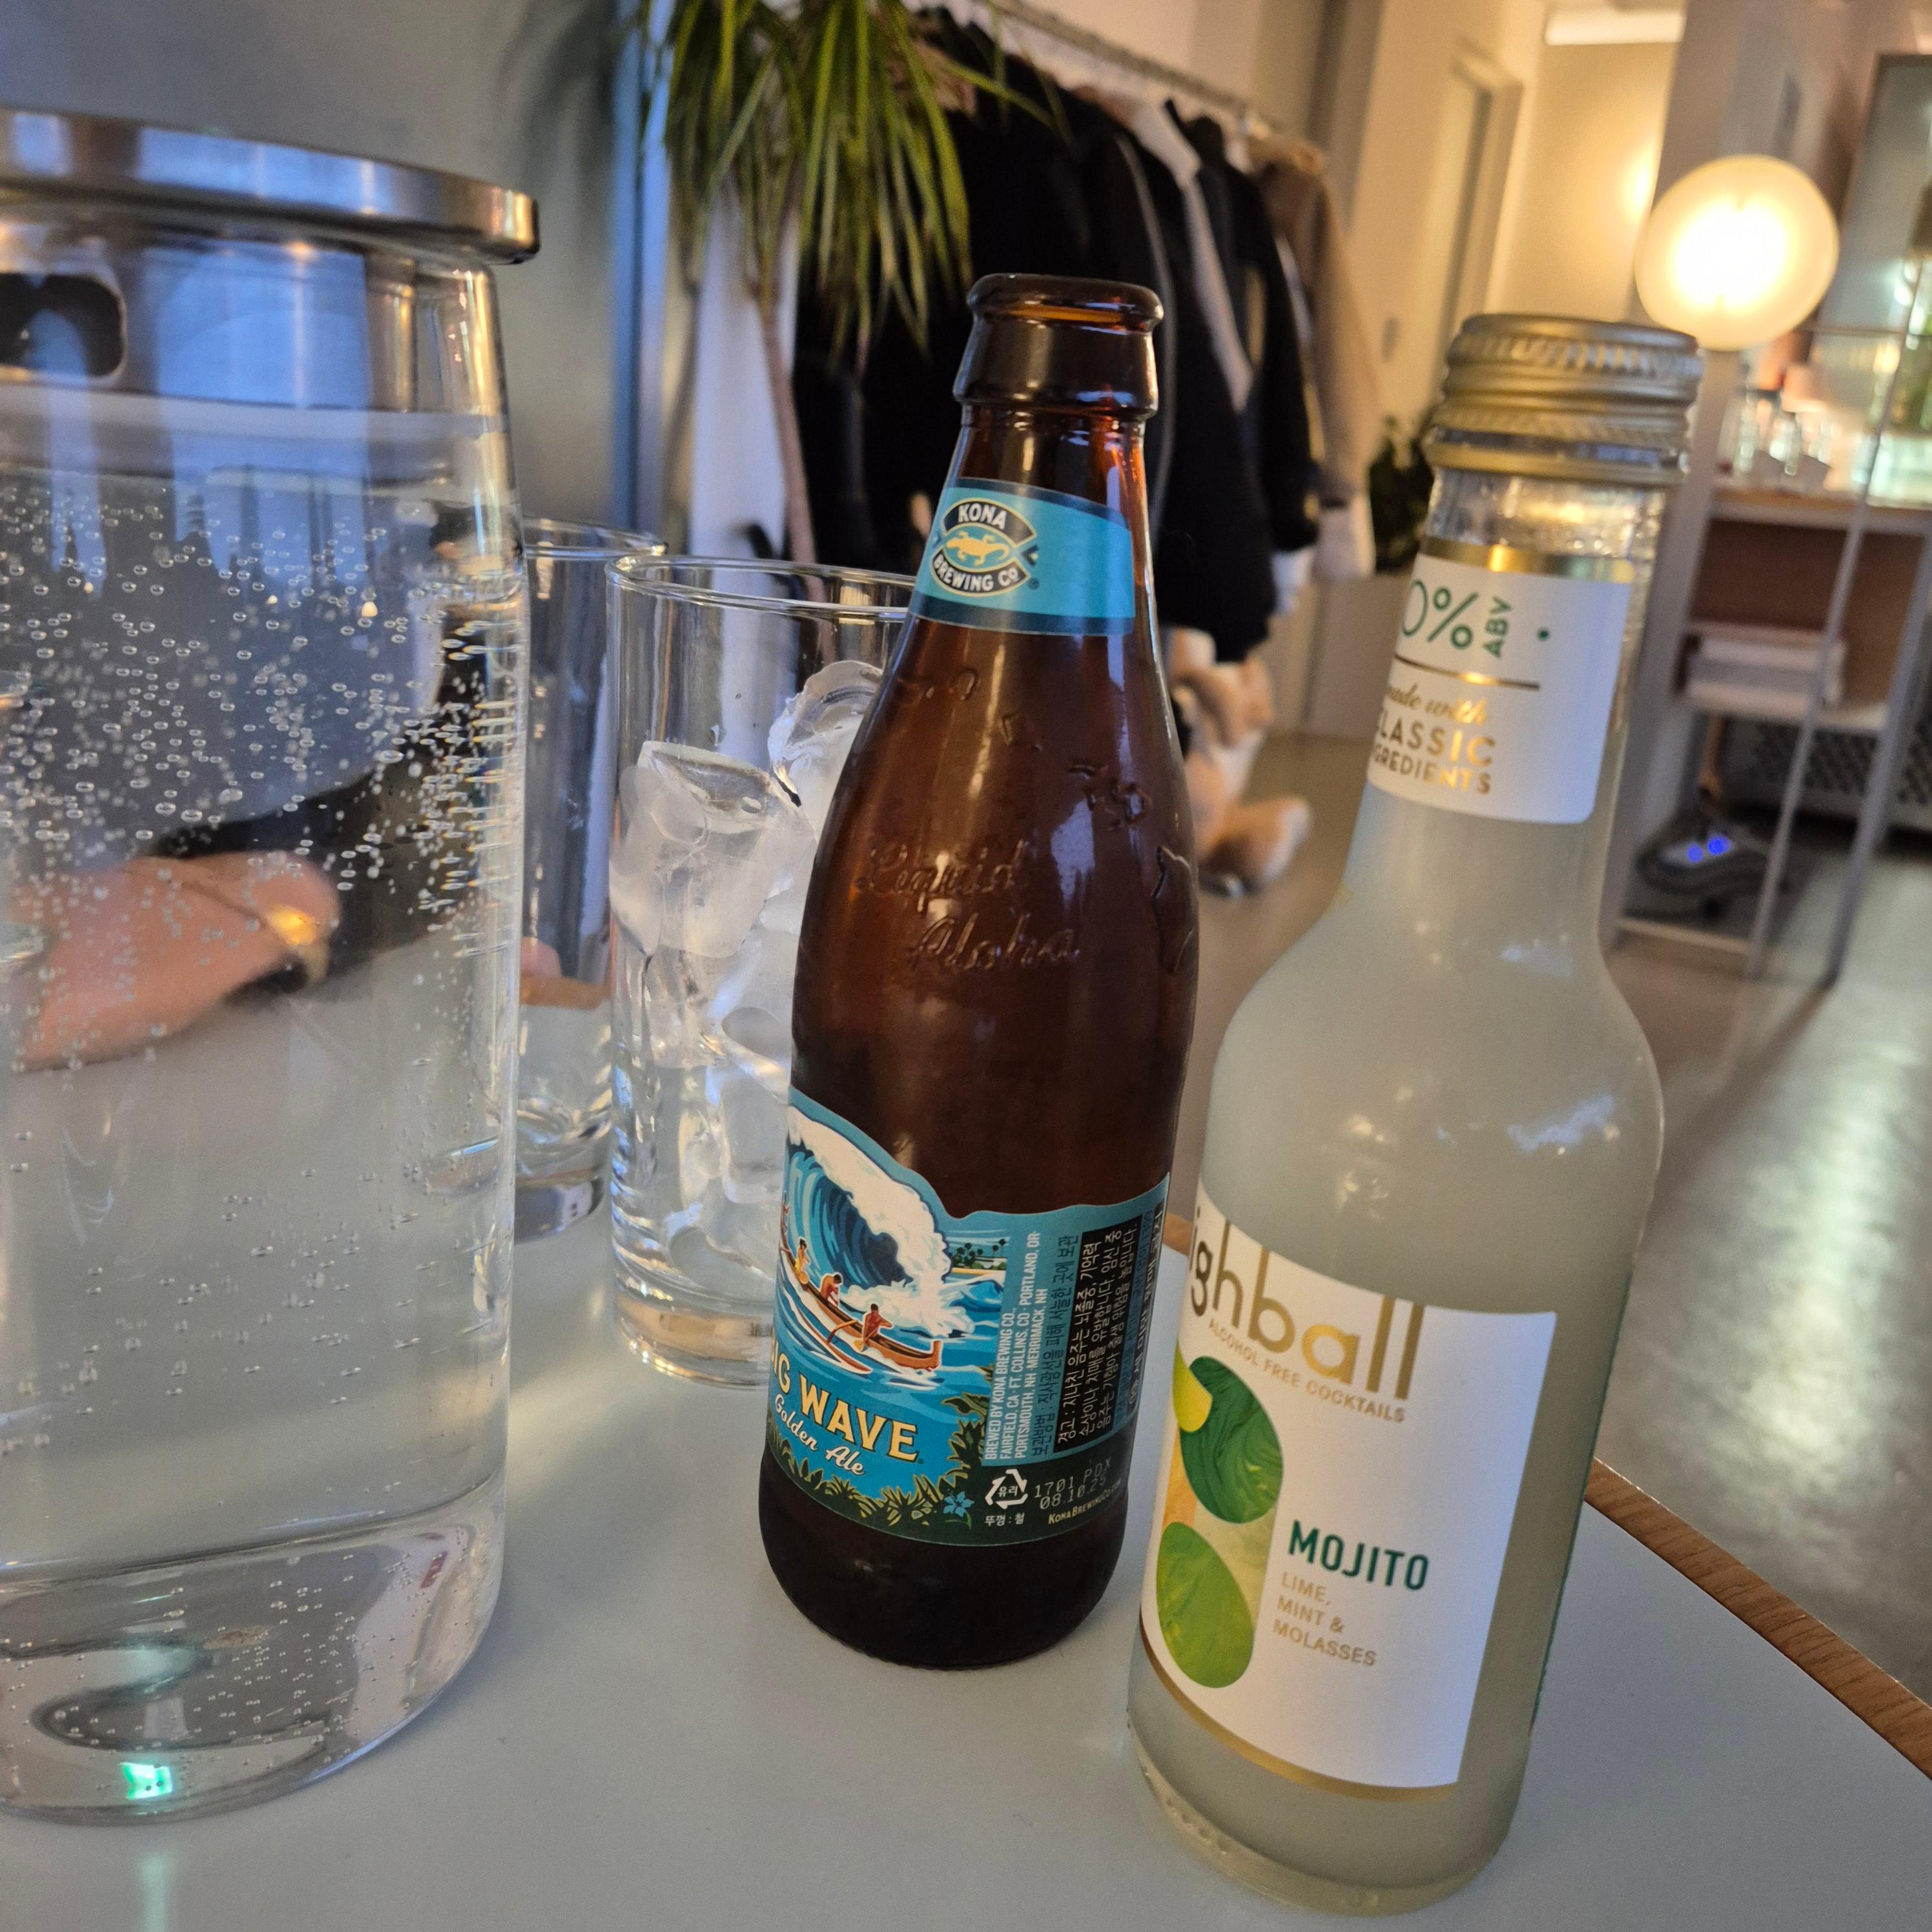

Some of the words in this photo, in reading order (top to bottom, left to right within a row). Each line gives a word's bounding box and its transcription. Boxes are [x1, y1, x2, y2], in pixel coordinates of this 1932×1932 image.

[958, 502, 1007, 530] KONA
[934, 553, 994, 591] BREWING
[1483, 597, 1512, 657] ABV
[1426, 697, 1488, 726] with
[1379, 711, 1495, 767] LASSIC
[1057, 1235, 1079, 1258] 보관
[1105, 1230, 1122, 1244] 중
[1019, 1249, 1039, 1306] PORTLAND,
[1053, 1260, 1076, 1284] 곳에
[1080, 1241, 1102, 1280] 기억력
[1101, 1246, 1120, 1273] 임신
[1017, 1313, 1031, 1326] CO
[1048, 1287, 1072, 1320] 서늘한
[1112, 1282, 1131, 1321] 위험을
[995, 1329, 1013, 1374] BREWING
[1024, 1373, 1037, 1387] NH
[1034, 1288, 1048, 1304] NH
[1045, 1323, 1065, 1347] 피해
[1068, 1328, 1091, 1366] 음주는
[1009, 1374, 1022, 1388] FT.
[1038, 1348, 1065, 1404] 직사광선을
[1085, 1345, 1107, 1385] 치매를
[1103, 1351, 1121, 1390] 기형아
[1209, 1318, 1259, 1366] ALCOHOL
[1263, 1359, 1299, 1388] FREE
[1305, 1379, 1406, 1423] COCKTAILS
[992, 1376, 1007, 1403] KONA
[1006, 1395, 1020, 1408] CA
[1063, 1369, 1085, 1408] 지나친
[799, 1373, 918, 1462] WAVE
[990, 1404, 1002, 1417] BY
[1079, 1387, 1100, 1437] 손상이나
[1096, 1390, 1116, 1429] 음주는
[776, 1393, 819, 1451] Golden
[826, 1445, 866, 1475] Ale
[985, 1421, 1001, 1459] BREWED
[1031, 1413, 1056, 1456] 보관방법
[1058, 1417, 1077, 1444] 경고
[997, 1485, 1019, 1498] 유리
[1034, 1476, 1075, 1499] 1701
[985, 1514, 1005, 1526] 뚜껑
[1014, 1512, 1025, 1525] 철
[1288, 1519, 1429, 1590] MOJITO
[1282, 1572, 1331, 1606] LIME,
[1278, 1594, 1324, 1626] MINT
[1329, 1616, 1344, 1633] &
[1273, 1618, 1377, 1667] MOLASSES
